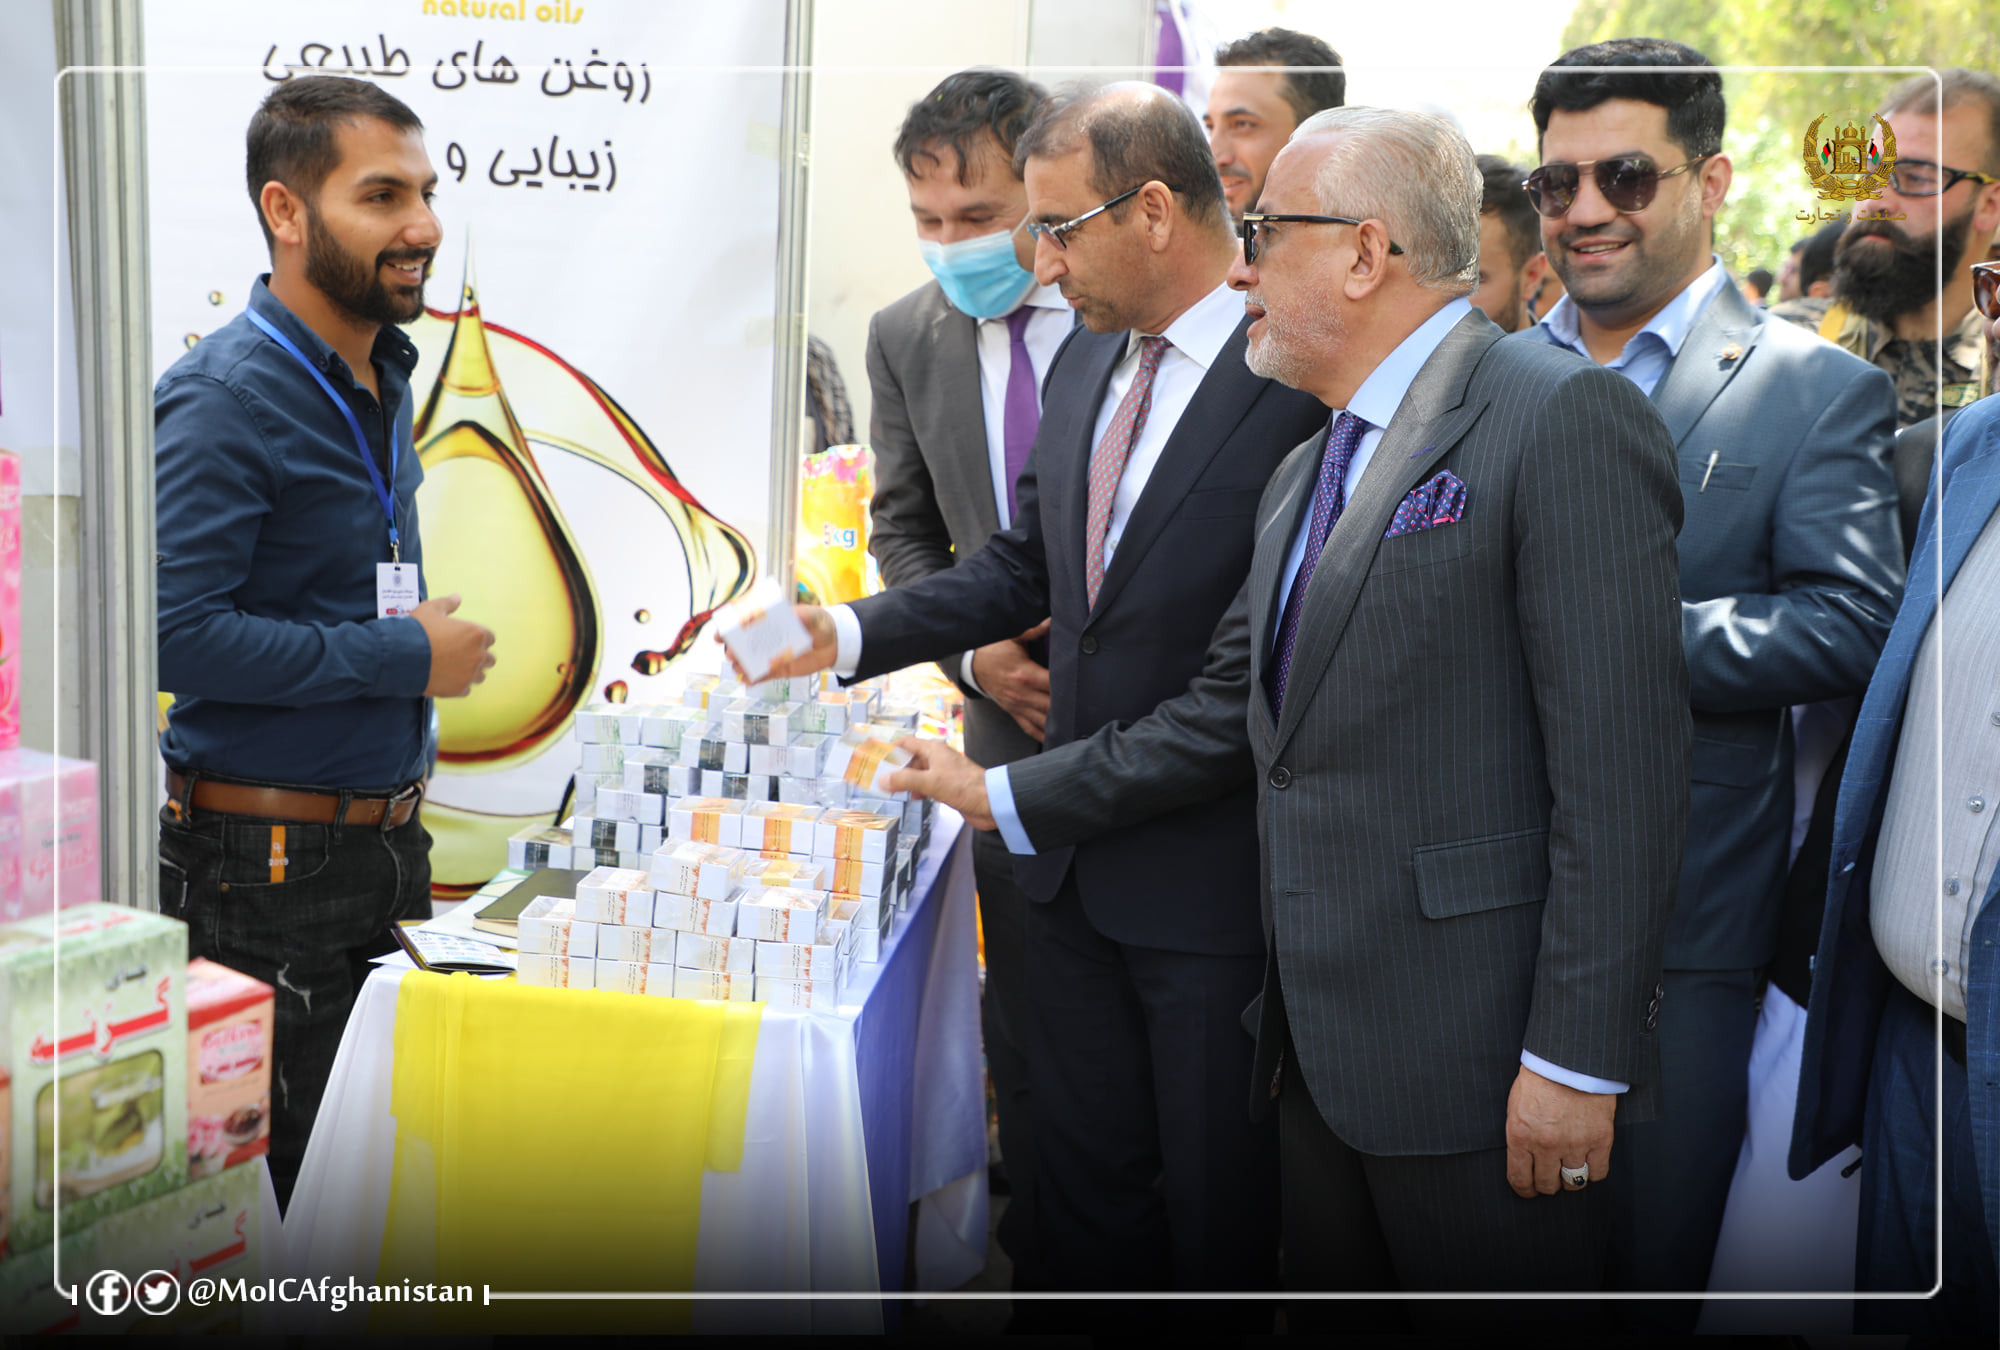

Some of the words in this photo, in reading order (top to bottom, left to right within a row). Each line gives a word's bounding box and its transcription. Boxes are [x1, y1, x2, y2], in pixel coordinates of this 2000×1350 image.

[422, 0, 526, 20] natural
[535, 0, 585, 24] oils
[432, 39, 520, 90] های
[541, 48, 652, 104] روغن
[446, 142, 467, 183] و
[488, 135, 618, 192] زیبایی
